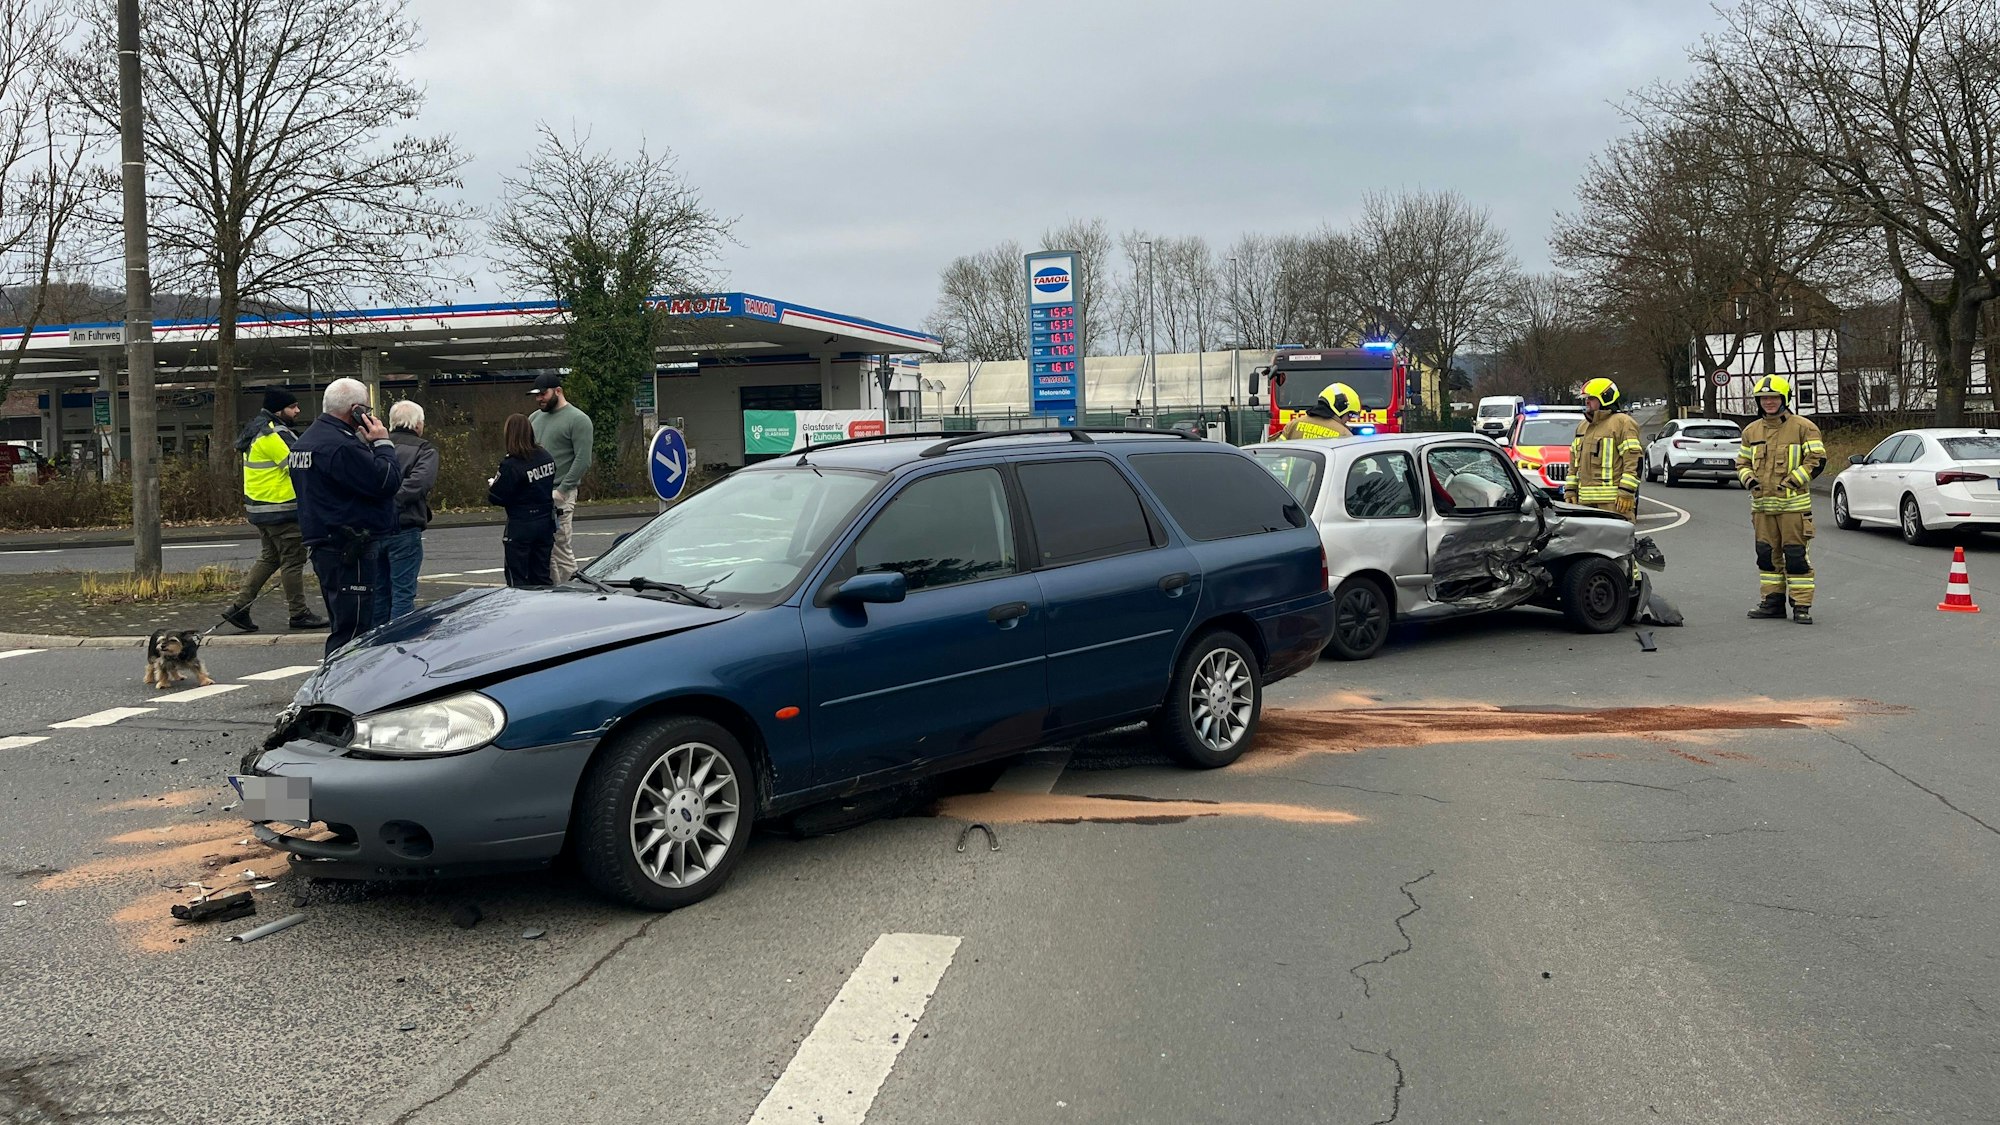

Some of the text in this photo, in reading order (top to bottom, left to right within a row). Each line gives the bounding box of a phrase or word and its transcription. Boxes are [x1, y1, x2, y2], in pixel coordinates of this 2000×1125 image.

[1033, 275, 1070, 284] TAMOIL
[644, 297, 731, 315] TAMOIL
[744, 298, 777, 318] TAMOIL
[73, 330, 121, 342] Am Fuhrweg
[1039, 376, 1071, 384] TAMOIL
[1716, 374, 1727, 383] 50
[802, 422, 844, 431] Glasfaser für
[1297, 421, 1340, 438] FEUERWEHR
[803, 433, 812, 441] Ir
